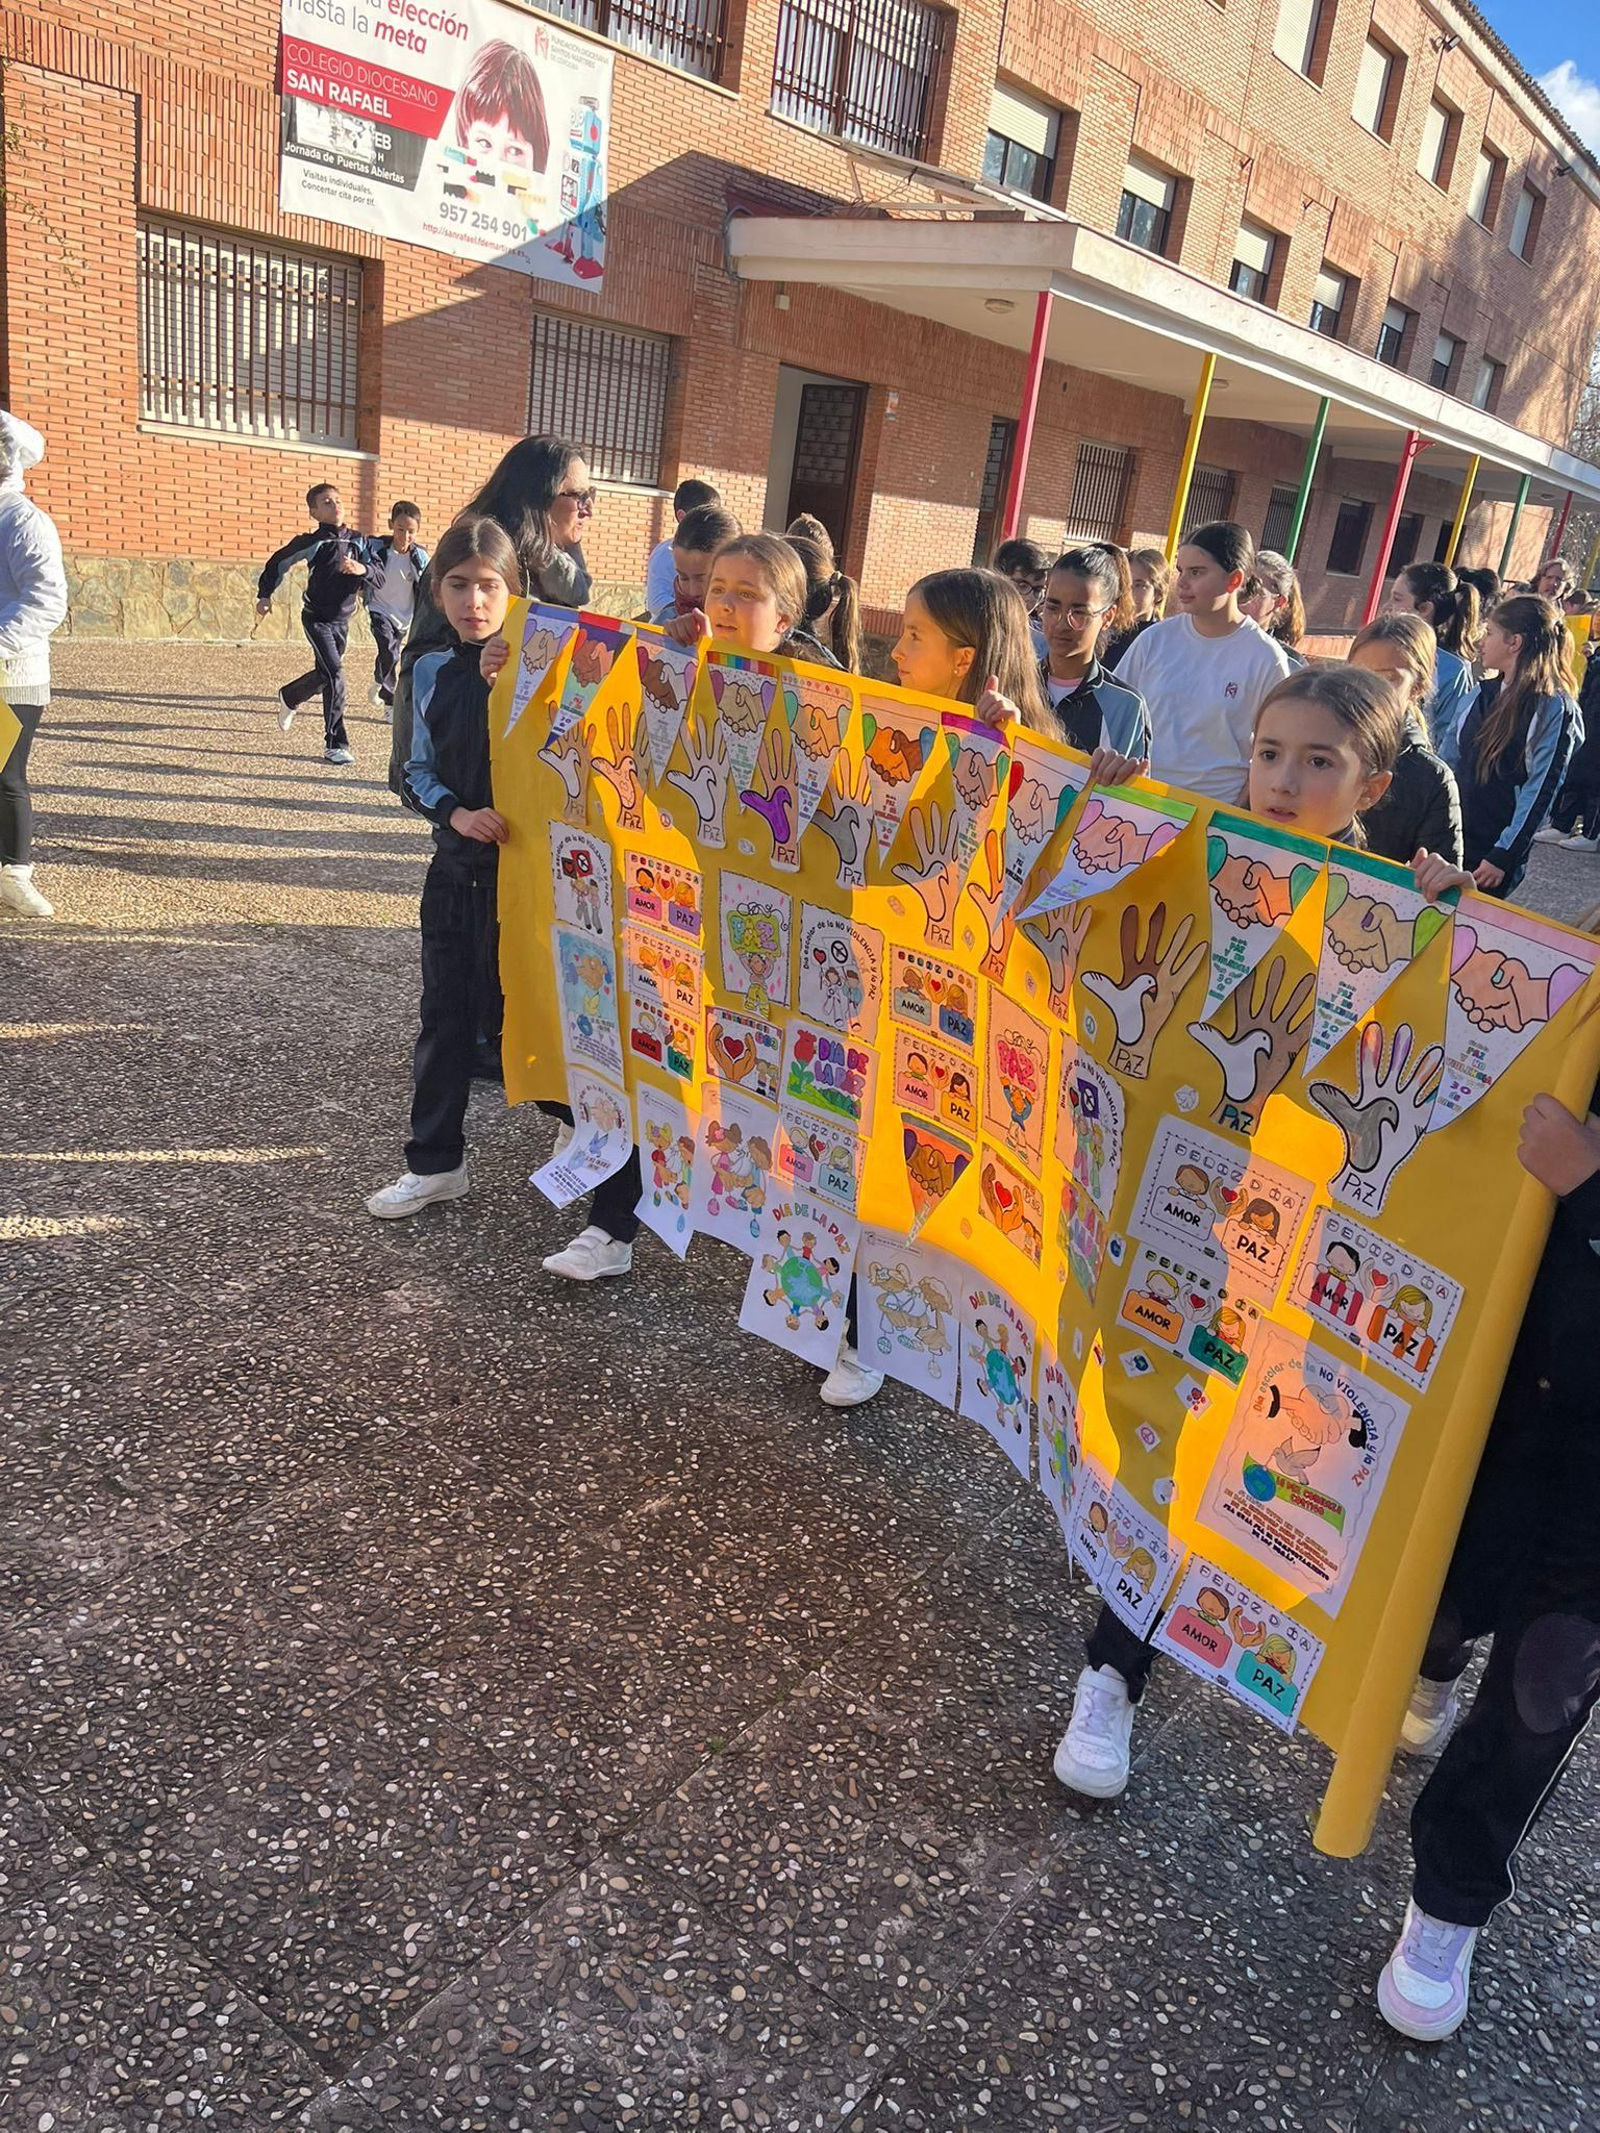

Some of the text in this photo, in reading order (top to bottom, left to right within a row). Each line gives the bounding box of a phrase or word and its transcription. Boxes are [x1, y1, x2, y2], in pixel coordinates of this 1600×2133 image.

[352, 6, 369, 34] la
[375, 20, 427, 54] meta
[387, 0, 469, 41] elección
[286, 43, 438, 107] COLEGIO DIOCESANO
[287, 68, 392, 119] SAN RAFAEL
[284, 141, 405, 184] Jornada de Puertas Abiertas
[303, 169, 327, 183] Visitas
[301, 180, 337, 197] Concertar
[338, 190, 352, 201] cita
[353, 195, 365, 204] por
[440, 201, 527, 242] 957 254 901
[623, 811, 642, 830] PAZ
[703, 824, 721, 842] PAZ
[777, 846, 797, 866] PAZ
[844, 867, 864, 887] PAZ
[635, 898, 655, 911] AMOR
[676, 910, 694, 927] PAZ
[804, 926, 816, 955] escolar
[817, 921, 825, 930] de
[826, 919, 834, 928] la
[835, 920, 844, 930] NO
[846, 925, 876, 964] VIOLENCIA
[931, 925, 950, 945] PAZ
[989, 954, 1005, 980] PAZ
[638, 975, 657, 989] AMOR
[676, 989, 694, 1006] PAZ
[901, 1000, 925, 1016] AMOR
[1052, 995, 1069, 1021] PAZ
[948, 1016, 967, 1036] PAZ
[1322, 1021, 1339, 1033] 30
[847, 1048, 869, 1076] DE
[903, 1037, 945, 1061] FELIZ
[1115, 1048, 1144, 1076] PAZ
[1466, 1046, 1485, 1060] PAZ
[674, 1056, 690, 1074] PAZ
[905, 1084, 928, 1100] AMOR
[1087, 1064, 1095, 1076] NO
[1095, 1072, 1118, 1125] VIOLENCIA
[1450, 1080, 1472, 1095] 30
[950, 1102, 970, 1122] PAZ
[1218, 1104, 1253, 1135] PAZ
[786, 1156, 806, 1172] AMOR
[1175, 1144, 1243, 1183] FELIZ
[827, 1174, 849, 1193] PAZ
[1342, 1172, 1377, 1207] PAZ
[1164, 1202, 1201, 1227] AMOR
[794, 1202, 809, 1218] DE
[812, 1208, 827, 1228] LA
[828, 1222, 850, 1255] PAZ
[1236, 1234, 1270, 1264] PAZ
[1326, 1218, 1395, 1266] FELIZ
[1145, 1250, 1211, 1290] FELIZ
[1312, 1281, 1349, 1310] AMOR
[987, 1291, 1001, 1308] DE
[1004, 1300, 1014, 1322] LA
[1015, 1319, 1033, 1355] PAZ
[1135, 1305, 1171, 1331] AMOR
[1382, 1323, 1419, 1357] PAZ
[1203, 1341, 1236, 1370] PAZ
[1288, 1359, 1302, 1369] de
[1305, 1360, 1315, 1373] la
[1260, 1362, 1284, 1393] escolar
[1319, 1366, 1334, 1382] NO
[1336, 1378, 1379, 1441] VIOLENCIA
[1363, 1453, 1376, 1465] la
[1367, 1443, 1377, 1454] y
[1351, 1465, 1370, 1487] PAZ
[1092, 1481, 1131, 1529] FELIZ
[1080, 1533, 1098, 1561] AMOR
[1116, 1578, 1143, 1610] PAZ
[1200, 1564, 1262, 1614] FELIZ
[1181, 1624, 1218, 1653] AMOR
[1252, 1668, 1286, 1701] PAZ
